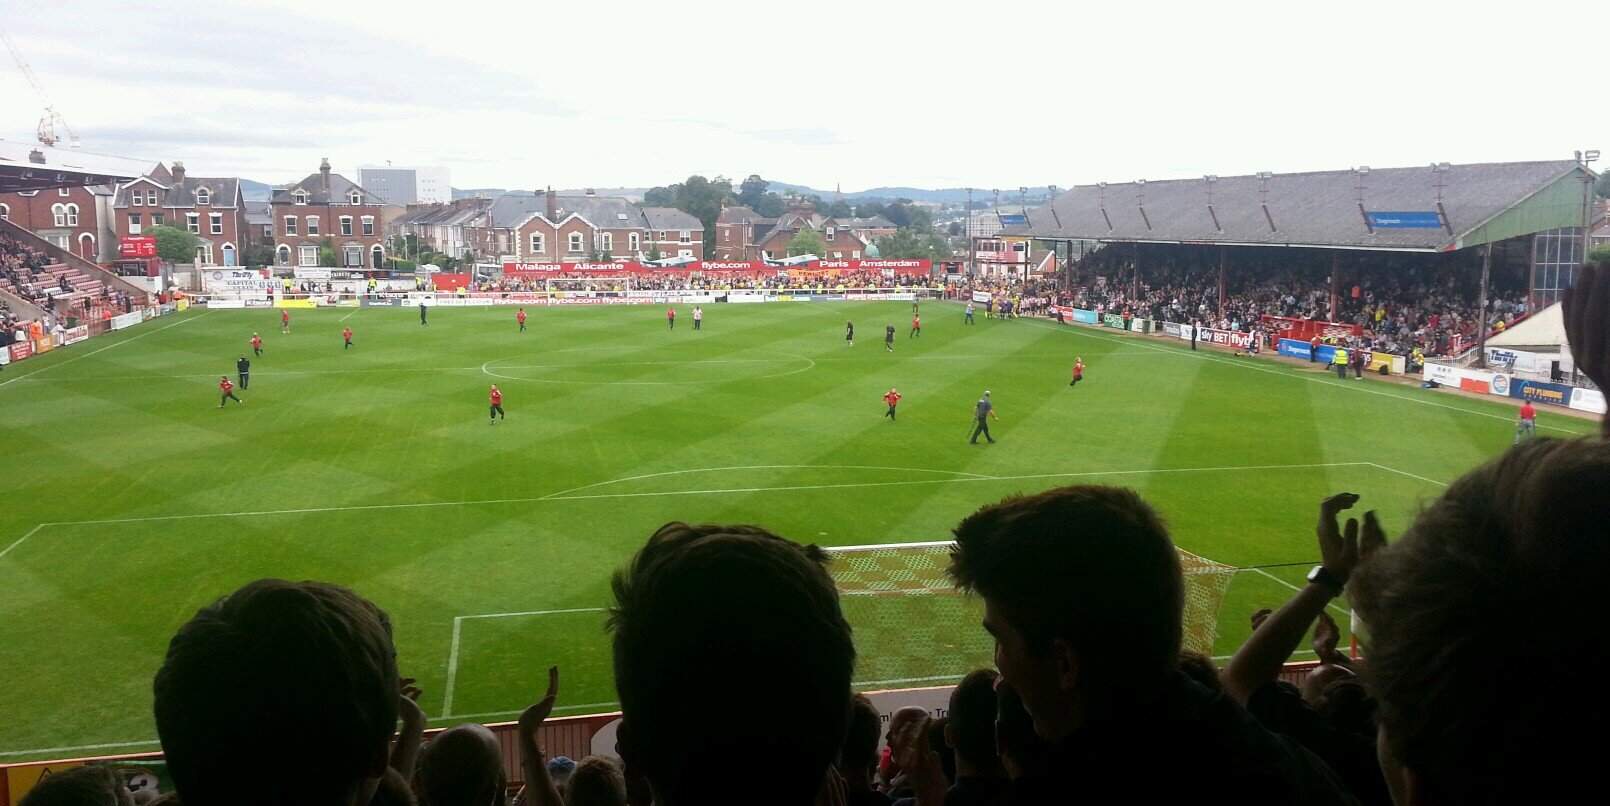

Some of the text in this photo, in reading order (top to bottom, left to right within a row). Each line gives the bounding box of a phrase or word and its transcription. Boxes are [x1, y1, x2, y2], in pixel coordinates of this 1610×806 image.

[515, 262, 624, 271] Malaga Alicante
[701, 261, 750, 269] flybe.com
[820, 260, 849, 268] Paris
[232, 271, 254, 279] Thrifty
[1201, 331, 1213, 342] sky
[1213, 332, 1229, 344] BET
[1523, 386, 1537, 395] CITY
